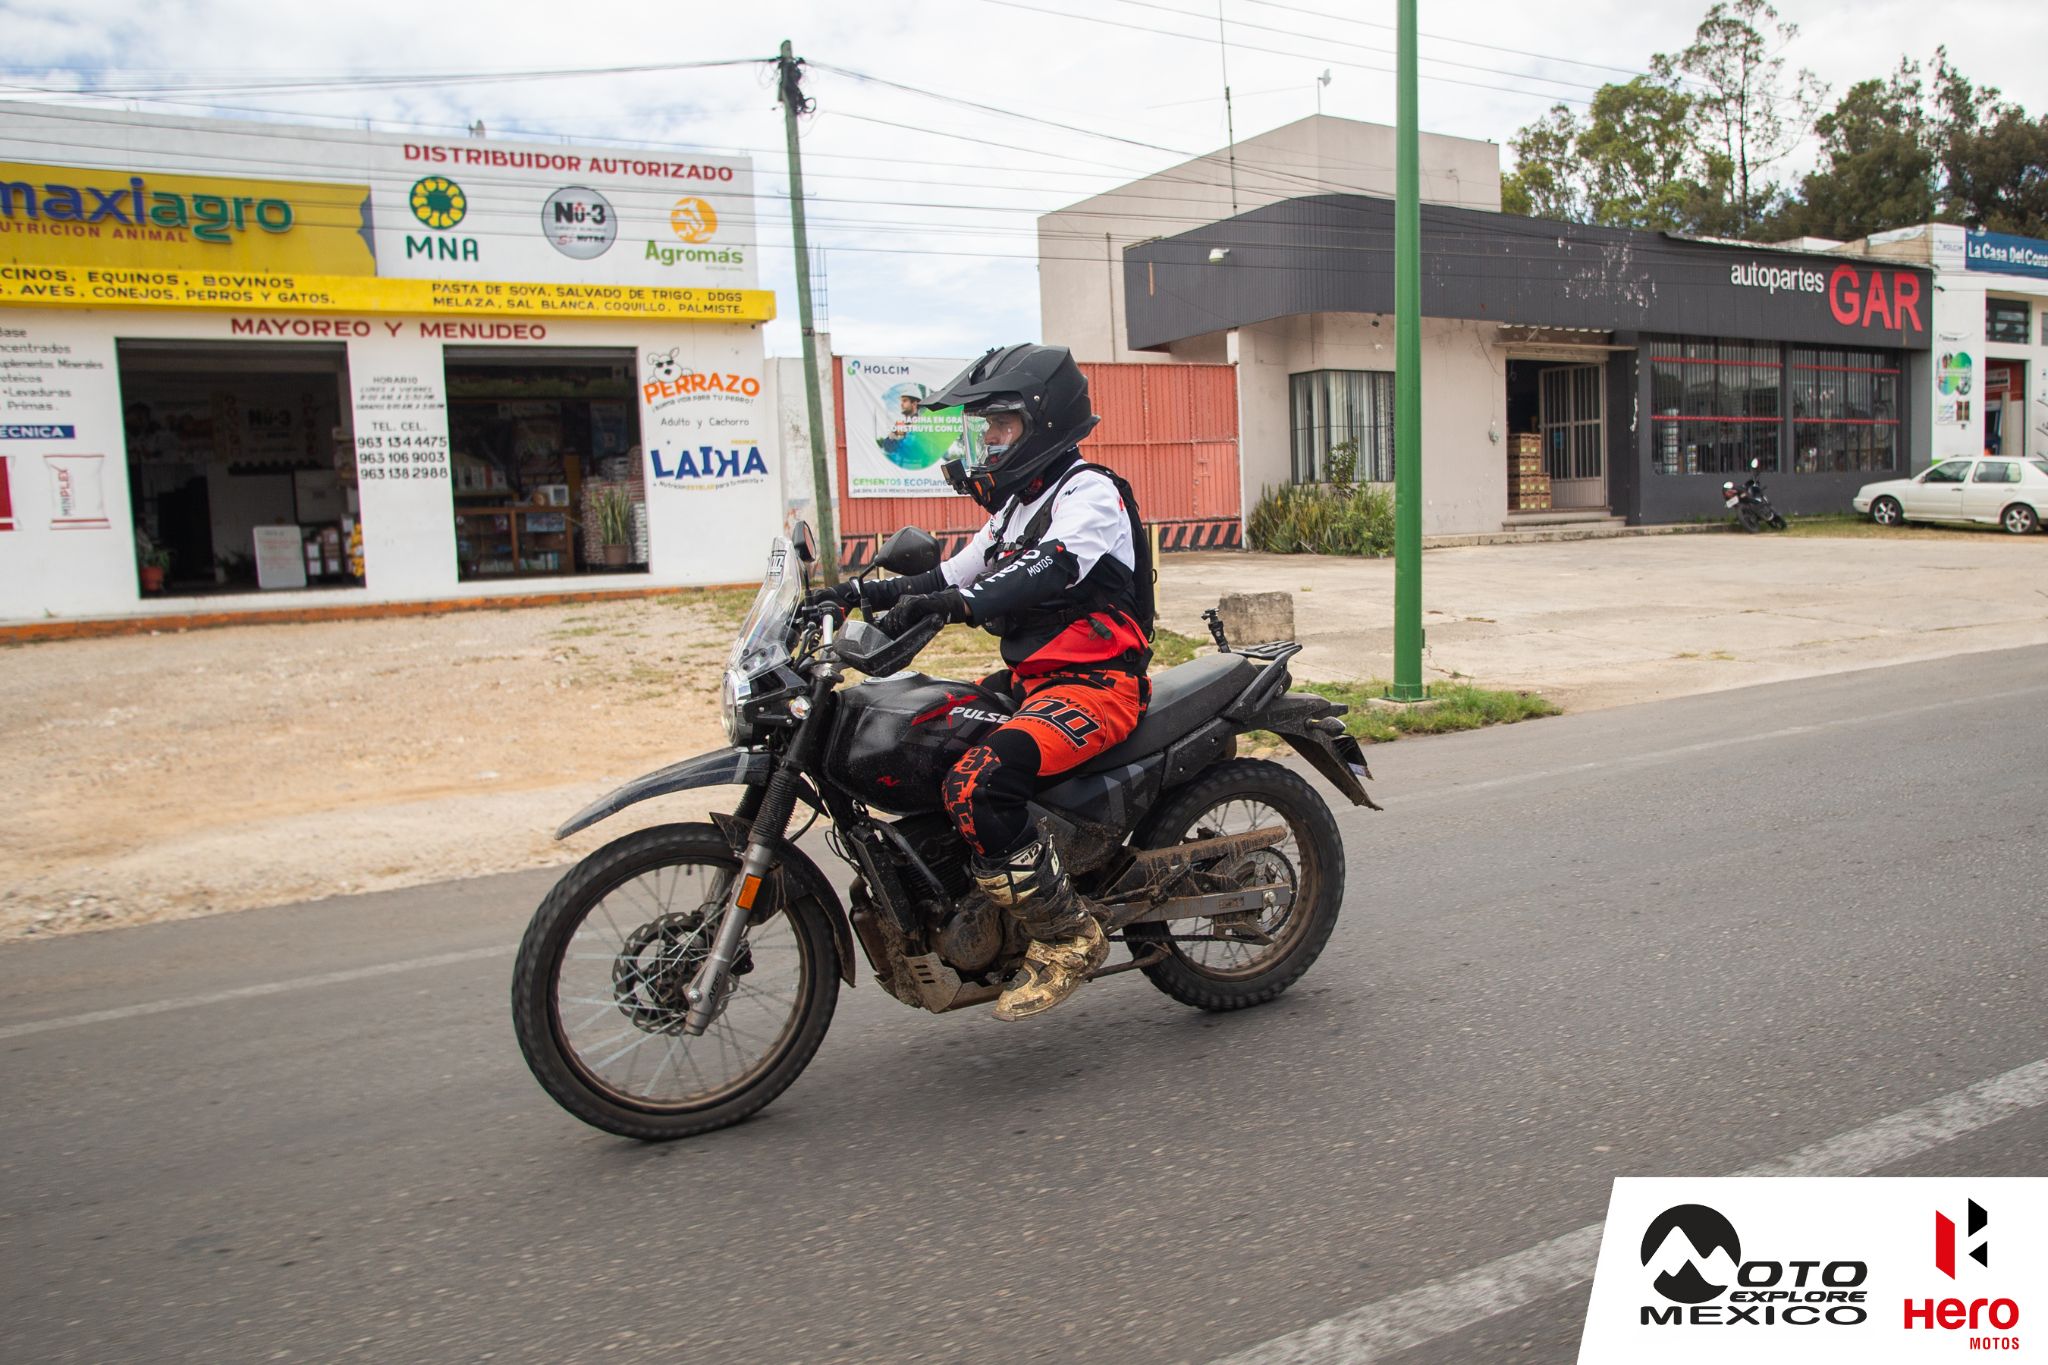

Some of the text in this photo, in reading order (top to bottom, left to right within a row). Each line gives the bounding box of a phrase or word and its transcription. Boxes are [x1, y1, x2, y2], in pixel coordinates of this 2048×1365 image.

[403, 143, 733, 182] DISTRIBUIDOR AUTORIZADO
[112, 228, 188, 243] ANIMAL
[405, 235, 479, 262] MNA
[644, 240, 744, 266] Agromás
[1967, 241, 1981, 258] La
[1982, 243, 2007, 261] Casa
[2009, 245, 2025, 263] Del
[203, 275, 295, 289] BOVINOS
[92, 286, 180, 301] CONEJOS.
[186, 290, 253, 302] PERROS
[260, 292, 272, 302] Y
[277, 292, 336, 304] GATOS.
[432, 283, 479, 295] PASTA
[485, 284, 503, 295] DE
[556, 287, 622, 299] SALVADO
[629, 289, 645, 300] DE
[707, 292, 743, 302] DDGS
[1730, 260, 1923, 332] autopartes GAR
[507, 299, 534, 309] SAL
[678, 303, 745, 314] PALMISTE.
[230, 318, 547, 340] MAYOREO Y MENUDEO
[864, 365, 909, 375] HOLCIM
[642, 372, 761, 405] PERRAZO
[372, 422, 428, 432] TEL. CEL.
[660, 417, 750, 429] Adulto y Cachorro
[891, 424, 933, 433] ONSTRUYE
[357, 437, 447, 448] 963 134 4475
[359, 451, 445, 464] 963 106 9003
[360, 467, 448, 480] 963 138 2988
[852, 478, 902, 487] CEMENTOS
[1026, 555, 1054, 577] MOTOS
